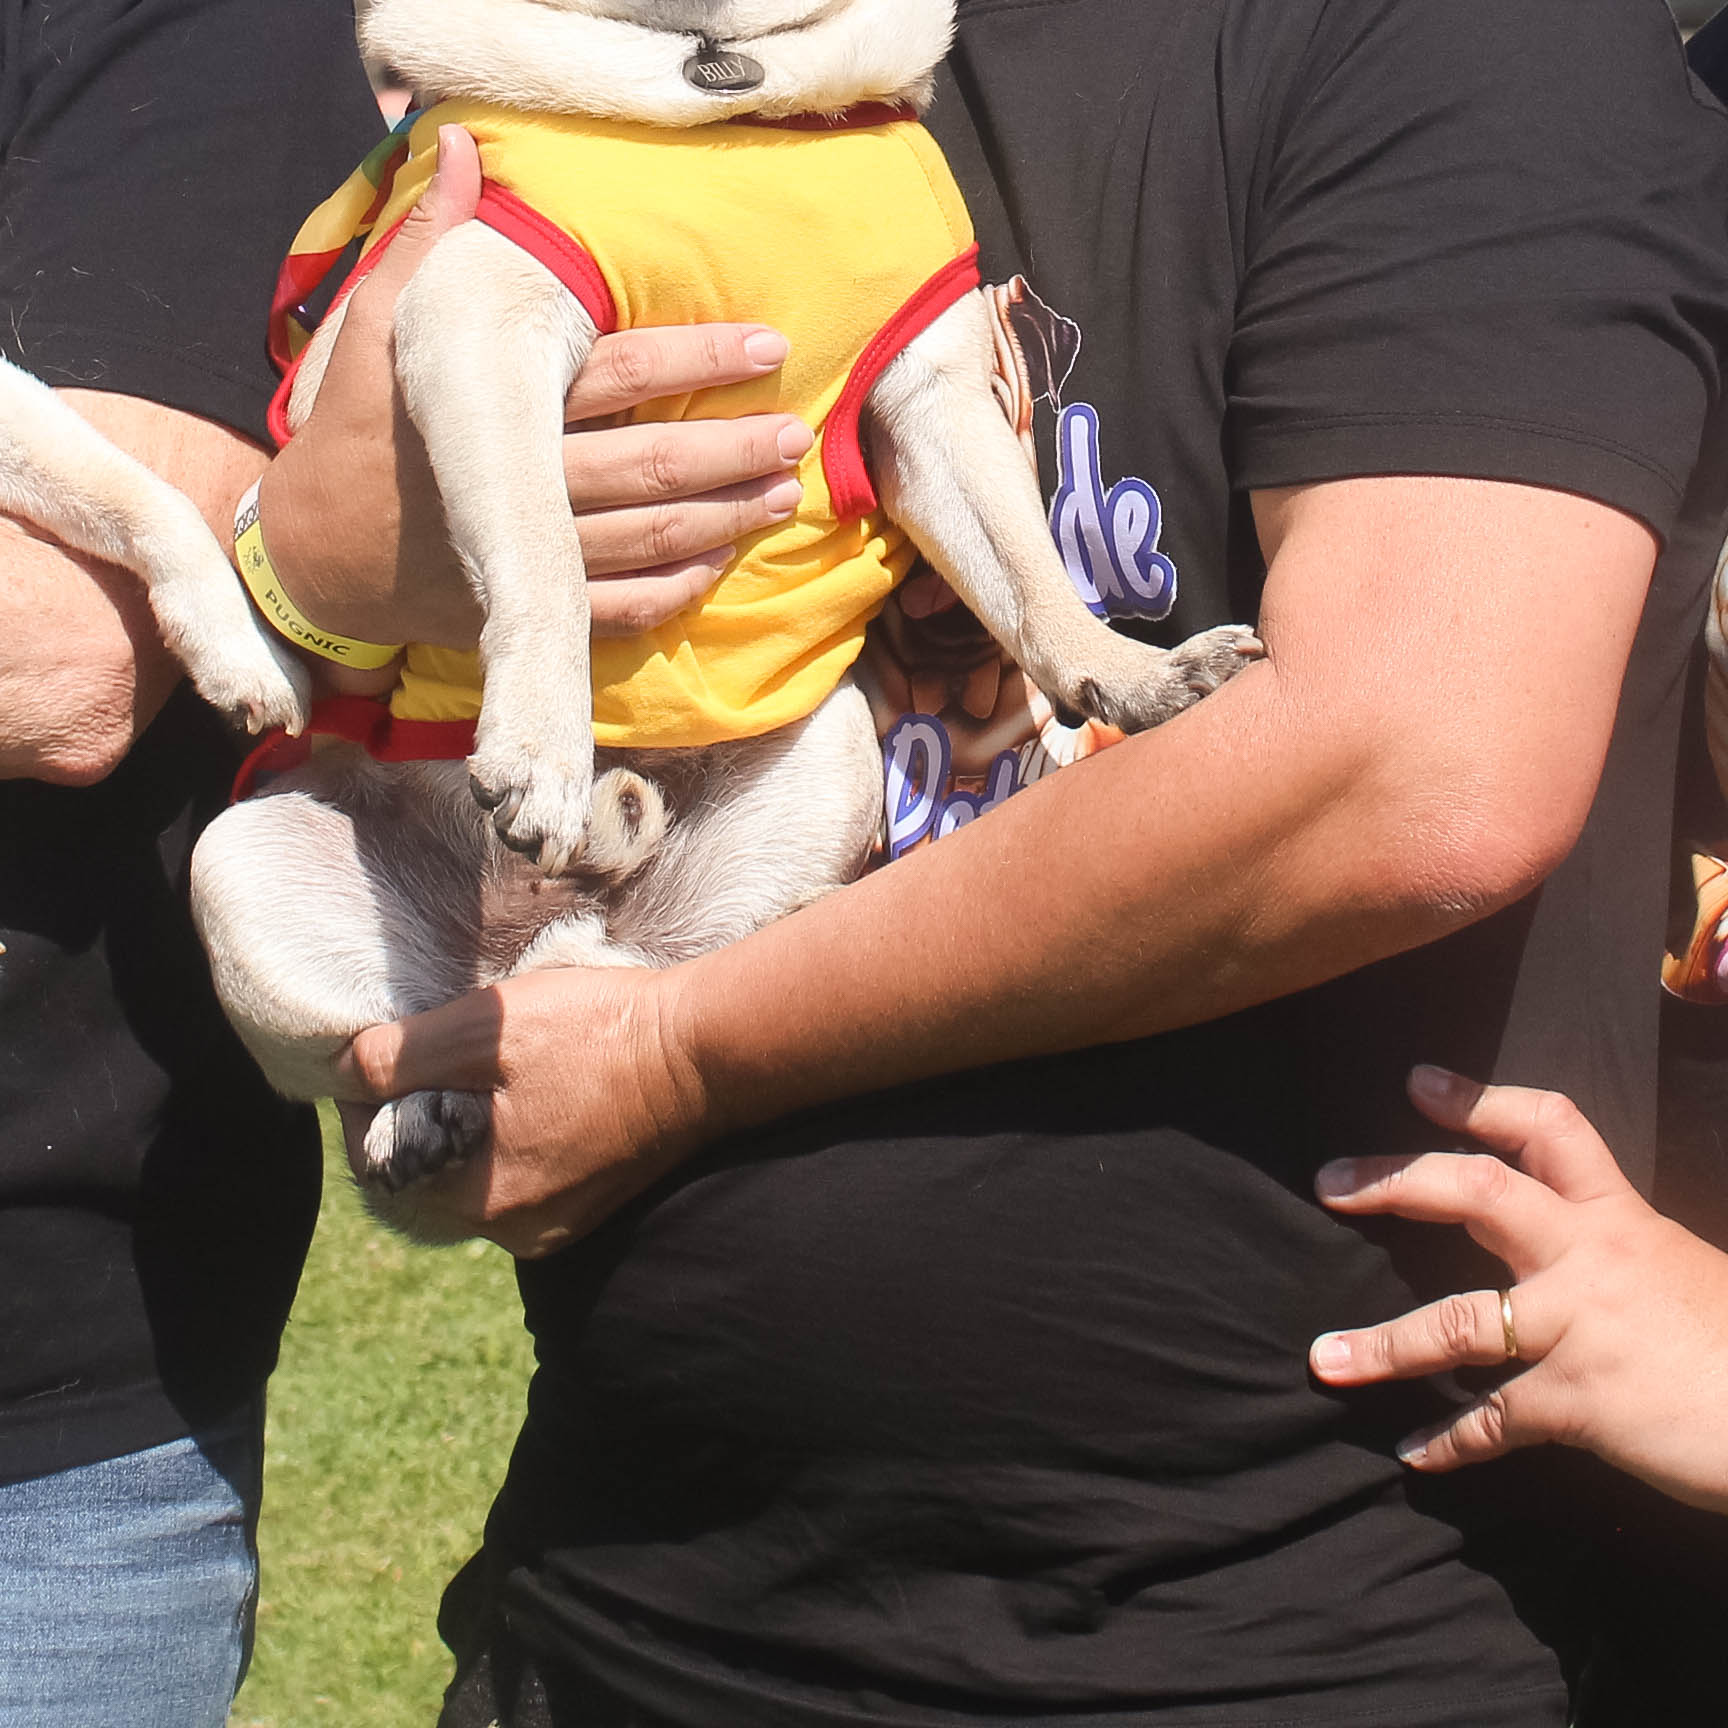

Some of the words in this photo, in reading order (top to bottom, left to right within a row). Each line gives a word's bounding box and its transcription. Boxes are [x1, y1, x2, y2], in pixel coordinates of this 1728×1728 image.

[697, 55, 745, 82] BILLY
[1052, 404, 1175, 618] de
[265, 588, 351, 657] PUGNIC
